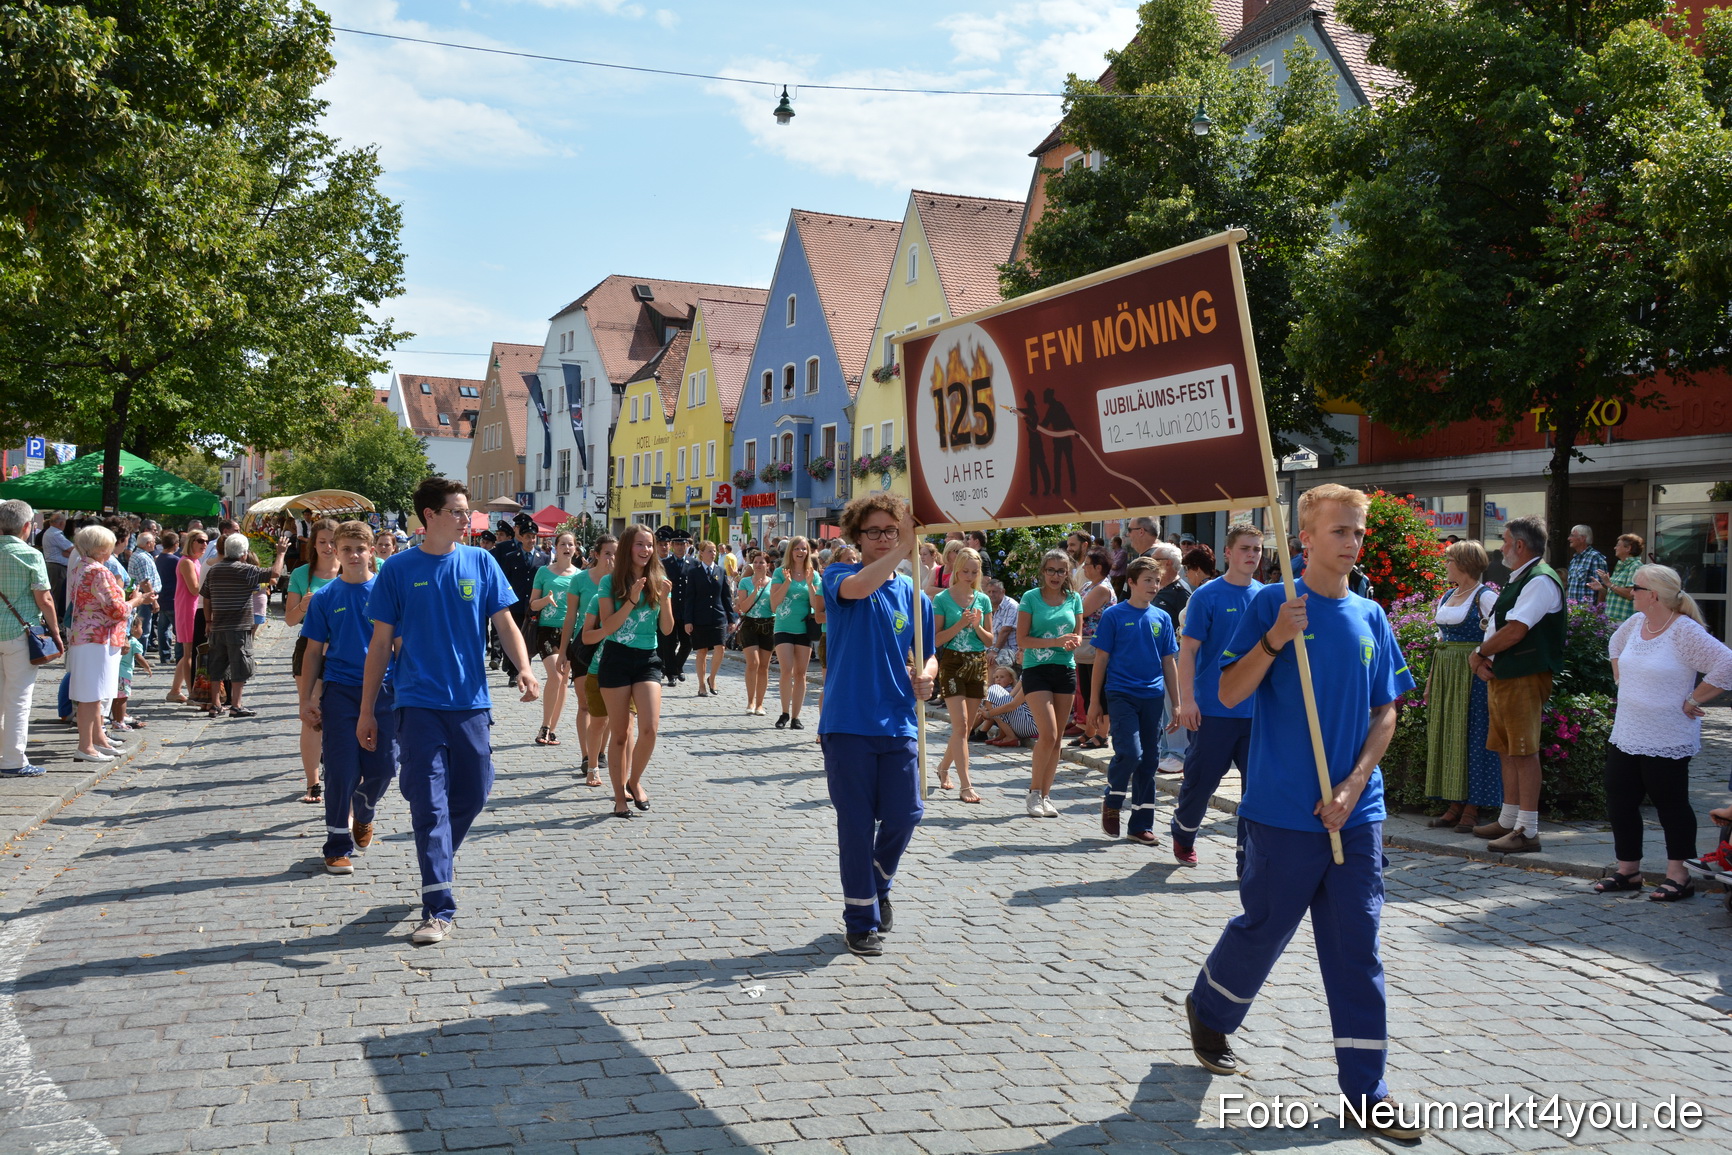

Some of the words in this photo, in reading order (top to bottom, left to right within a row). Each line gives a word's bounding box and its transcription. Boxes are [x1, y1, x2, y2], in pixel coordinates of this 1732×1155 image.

[1025, 324, 1083, 375] FFW
[1091, 290, 1218, 359] MÖNING
[1103, 379, 1215, 417] JUBILÄUMS-FEST
[933, 376, 995, 449] 125
[1156, 414, 1182, 438] Juni
[1184, 408, 1221, 433] 2015
[30, 439, 41, 456] P
[636, 436, 651, 449] HOTEL
[943, 459, 995, 484] JAHRE
[741, 492, 776, 509] APOTHEKE
[952, 489, 967, 502] 1890
[972, 487, 989, 501] 2015
